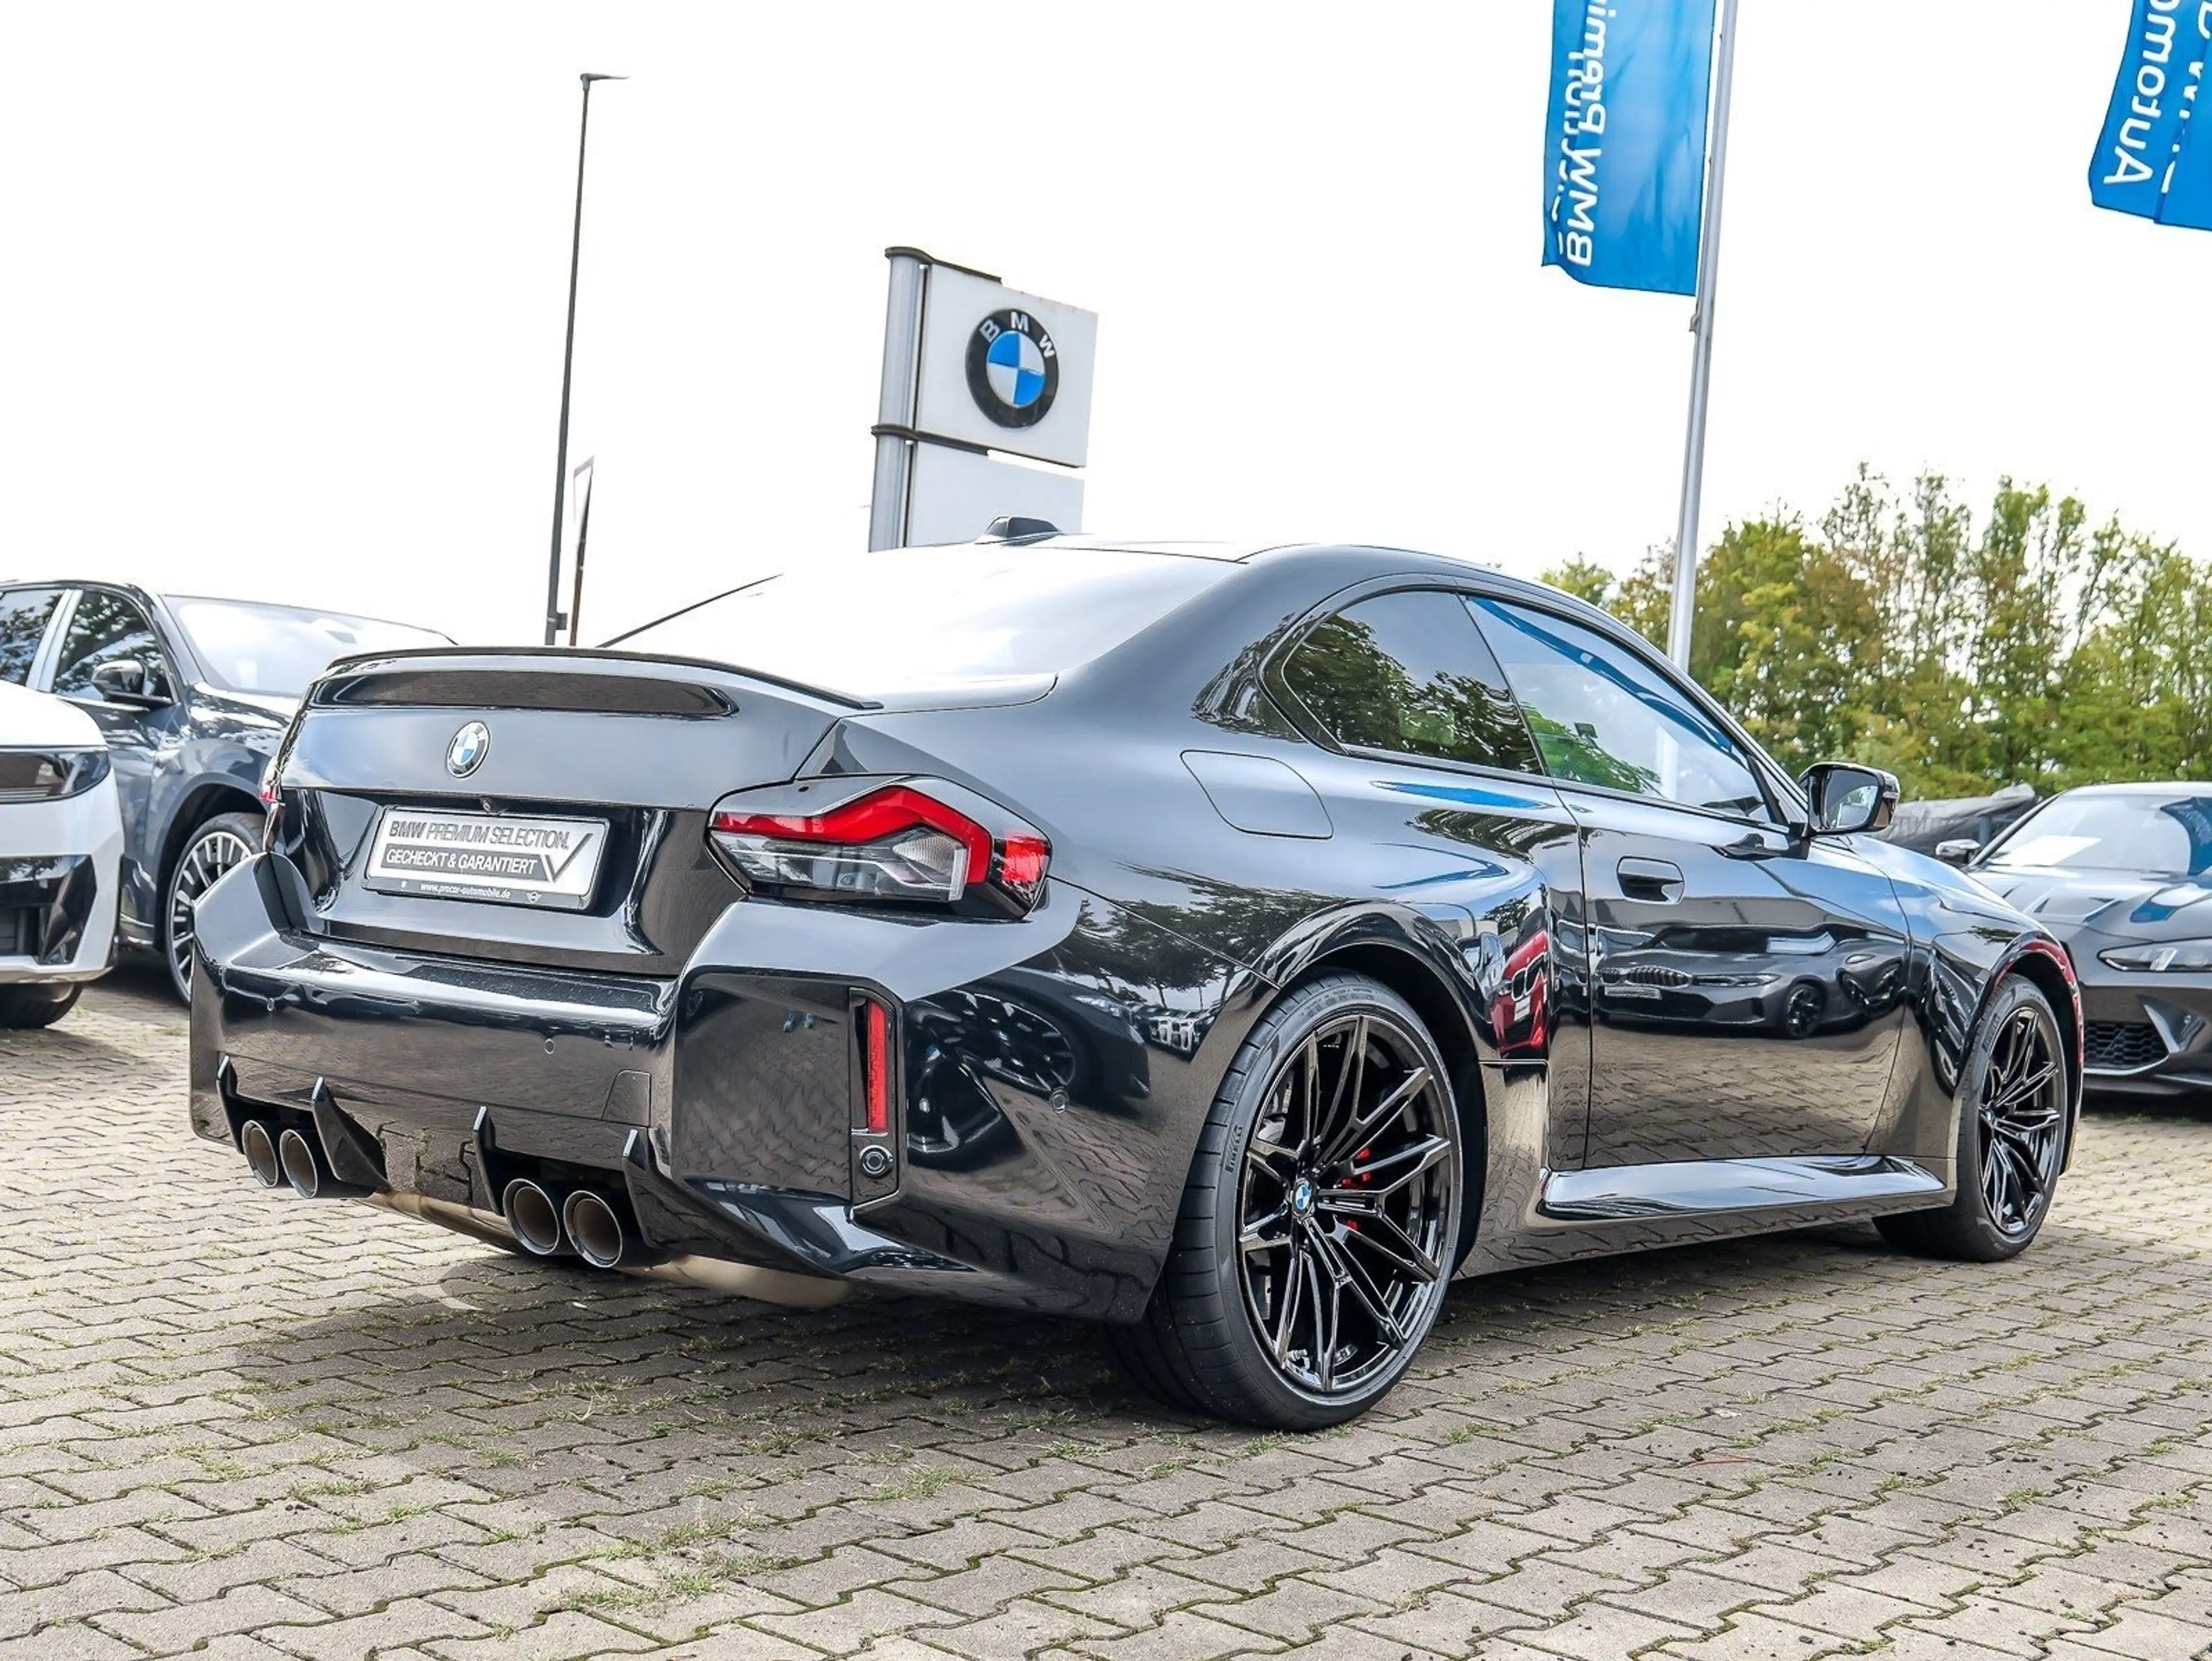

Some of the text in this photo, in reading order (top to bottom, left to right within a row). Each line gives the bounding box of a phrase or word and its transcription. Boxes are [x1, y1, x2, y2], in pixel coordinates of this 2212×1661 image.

[979, 311, 1056, 358] BMW
[389, 821, 427, 839] BMW
[426, 822, 491, 843] PREMIUM
[386, 848, 538, 875] GECHECKT & GARANTIERT
